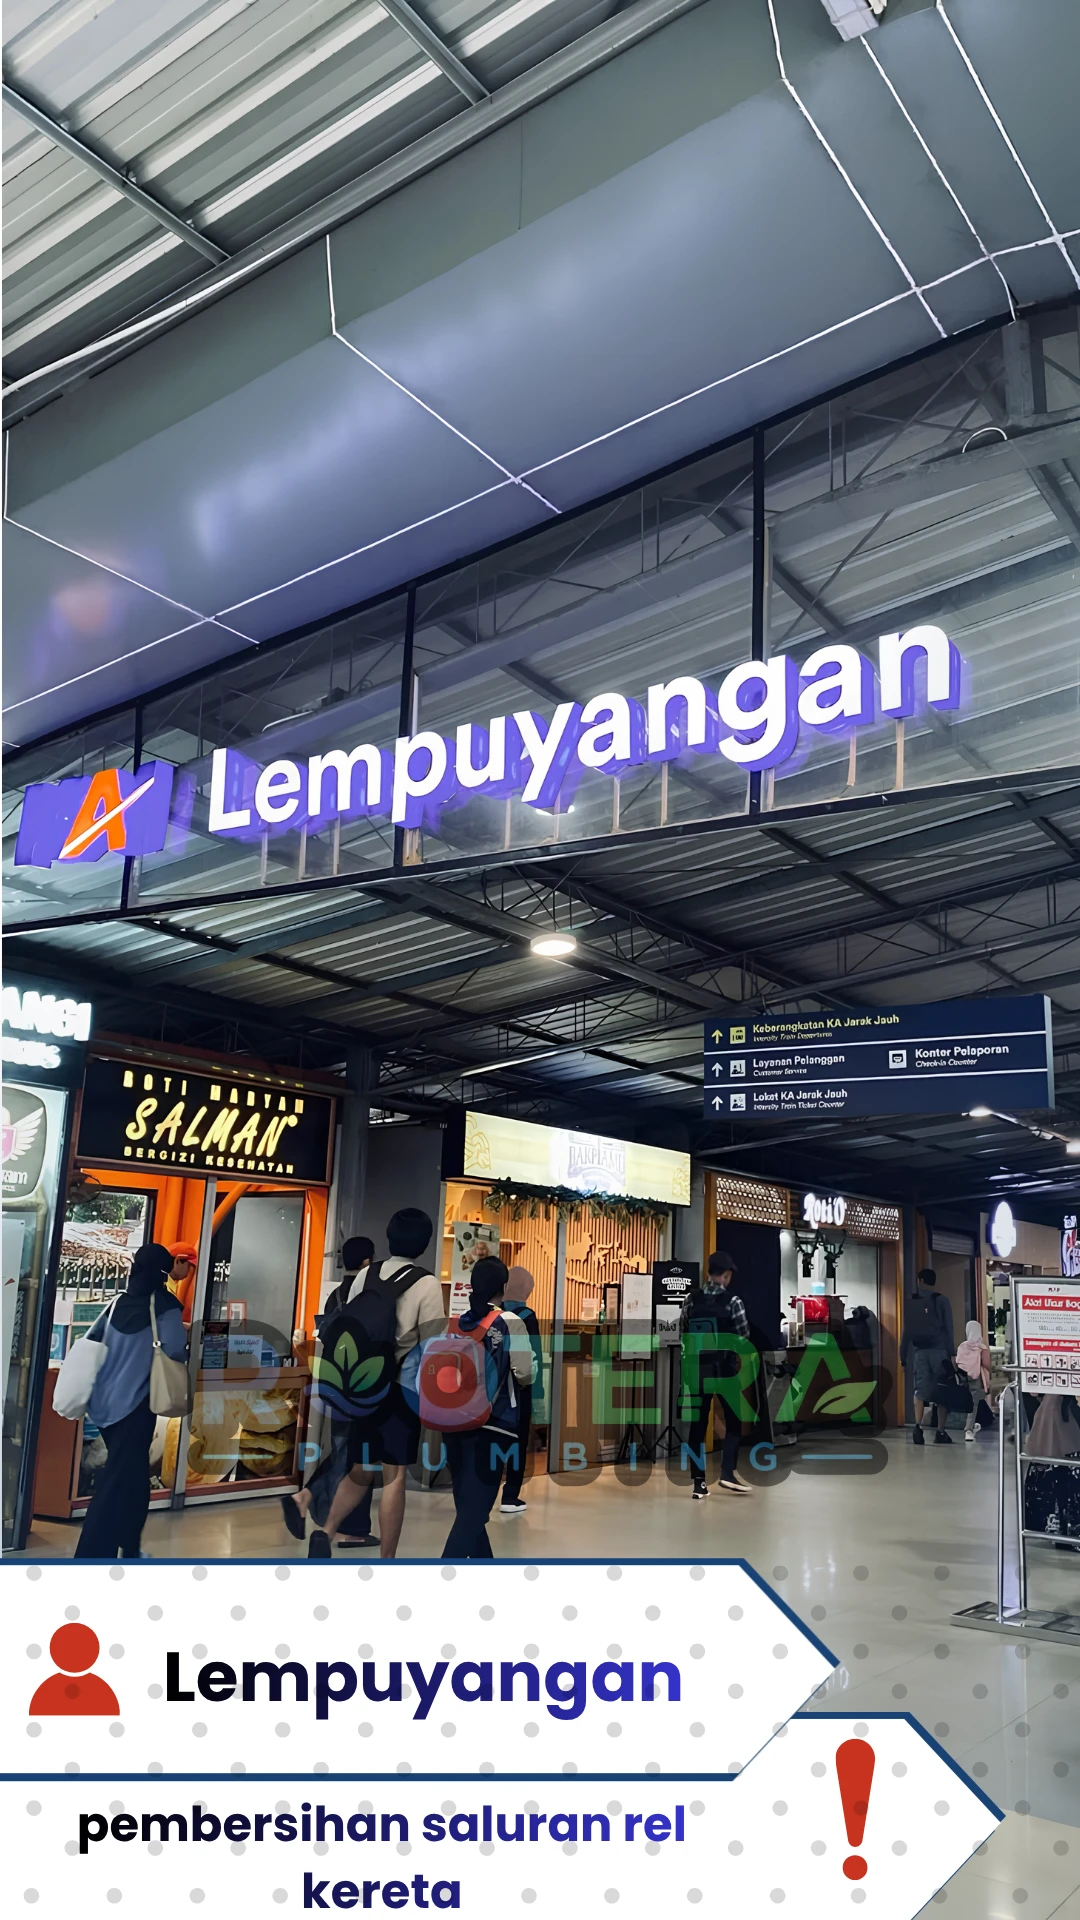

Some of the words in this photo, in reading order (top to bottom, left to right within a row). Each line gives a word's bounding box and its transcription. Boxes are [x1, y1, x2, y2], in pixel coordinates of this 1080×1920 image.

[208, 624, 951, 833] Lempuyangan
[753, 1019, 825, 1034] Keberangkatan
[826, 1018, 842, 1029] KA
[843, 1016, 872, 1028] Jarak
[874, 1014, 900, 1026] Jauh
[953, 1045, 1010, 1058] Pelaporan
[753, 1057, 793, 1070] Layanan
[794, 1055, 846, 1067] Pelanggan
[780, 1090, 795, 1101] KA
[796, 1089, 823, 1100] Jarak
[824, 1088, 848, 1099] Jauh
[125, 1097, 290, 1158] SALMAN
[123, 1145, 196, 1164] BERGIZI
[205, 1155, 294, 1175] KESEHATAN
